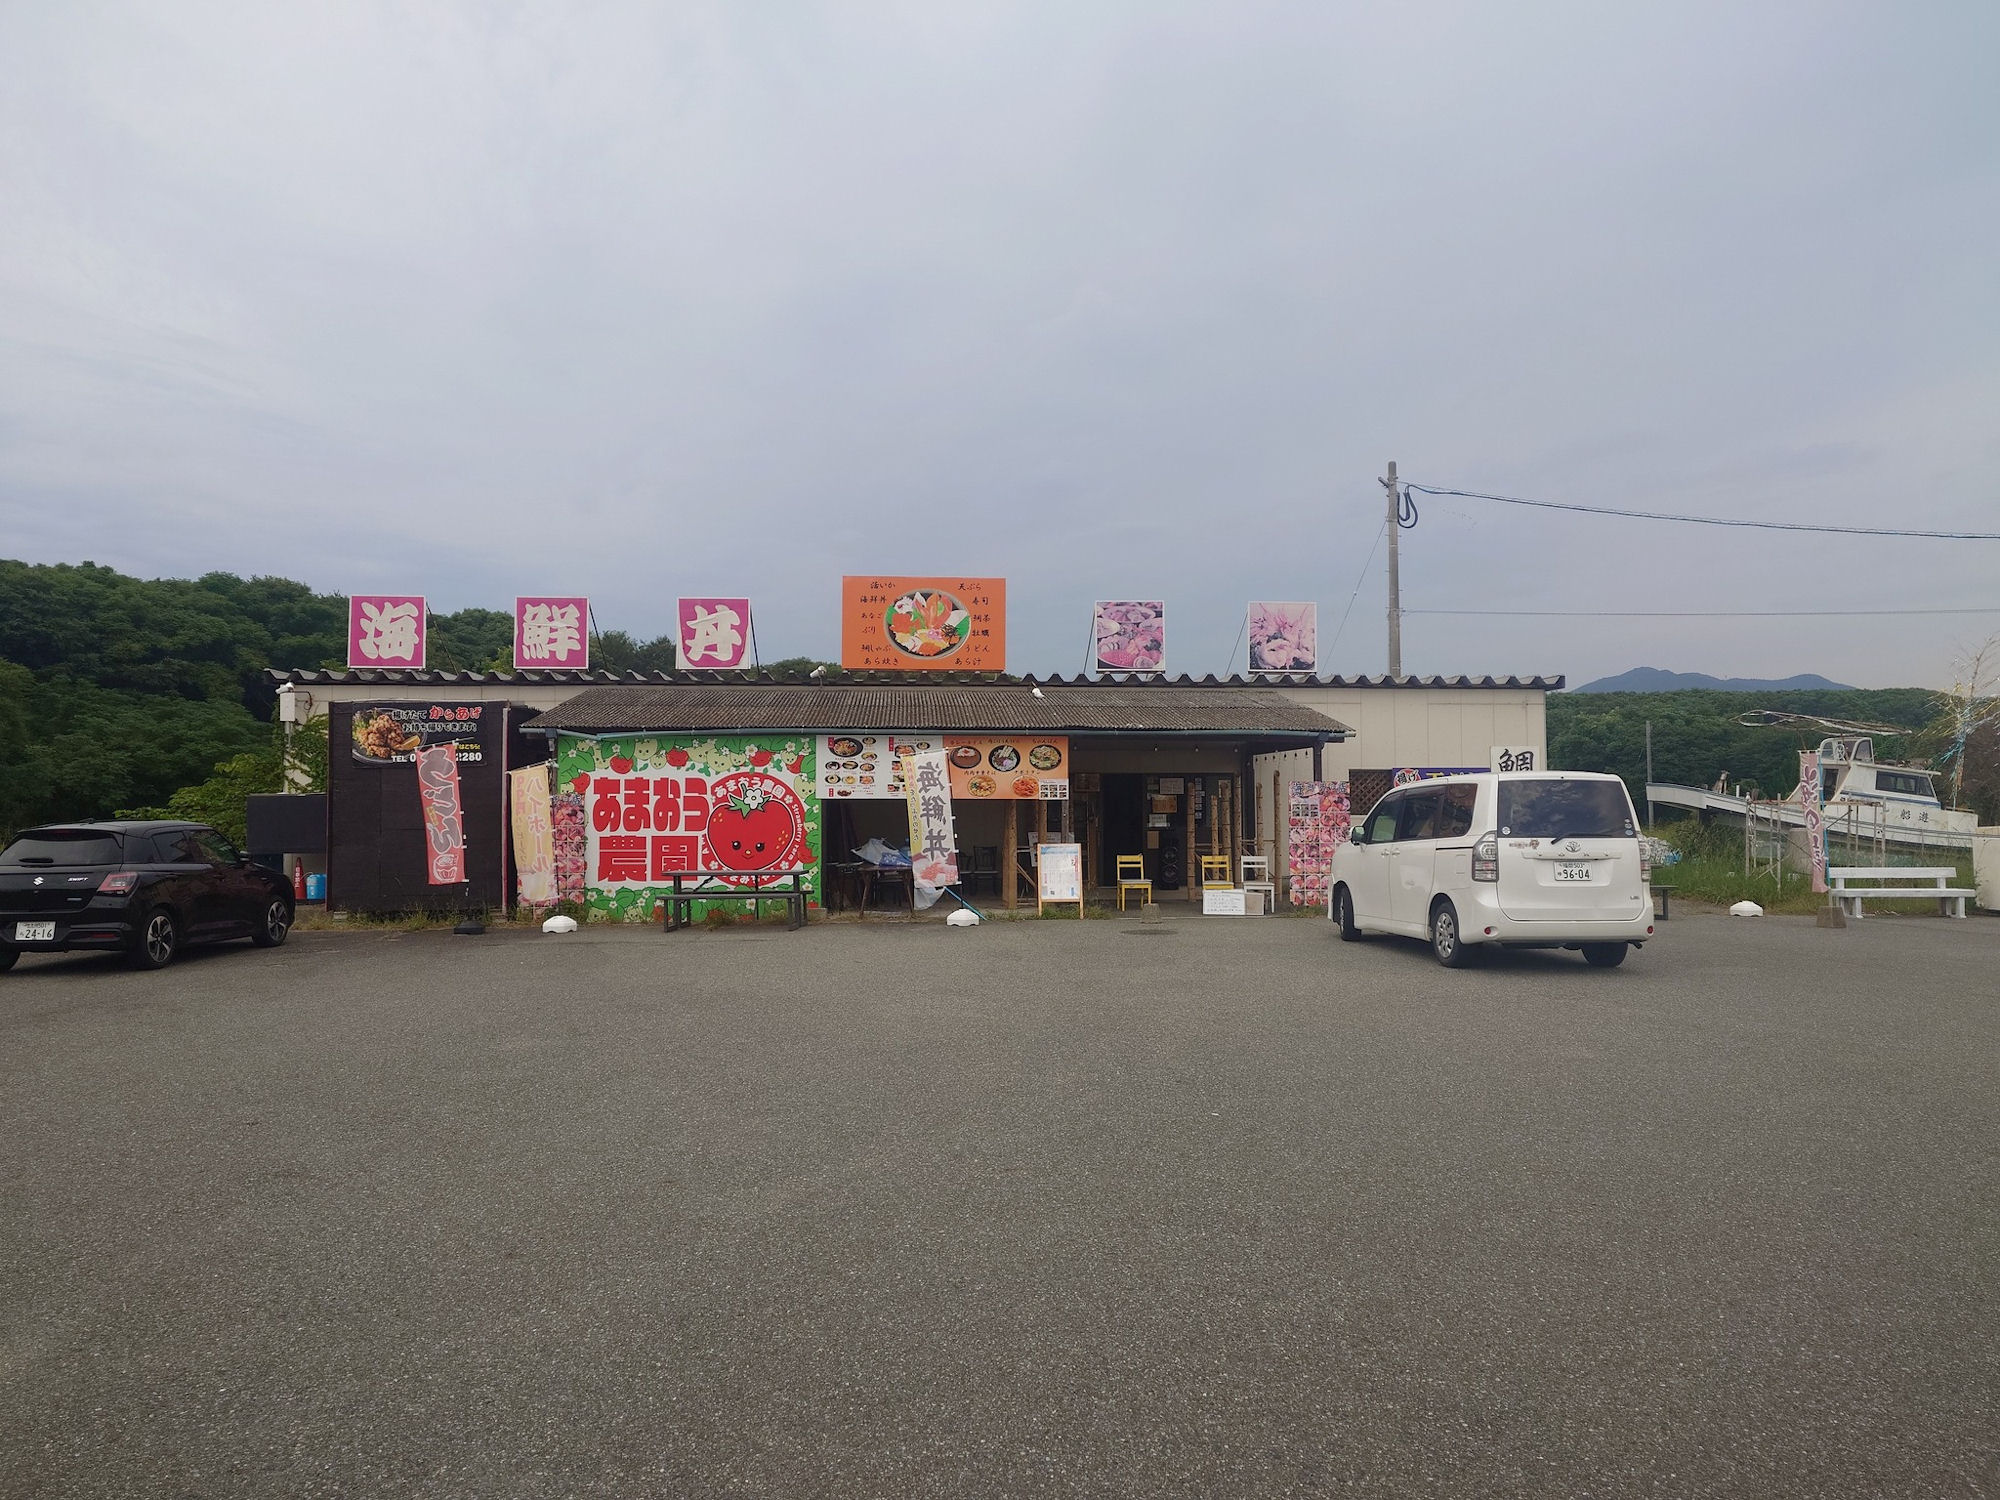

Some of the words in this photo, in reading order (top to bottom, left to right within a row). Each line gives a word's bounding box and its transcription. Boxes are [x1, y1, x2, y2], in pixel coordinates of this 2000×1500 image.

[870, 581, 896, 589] 活いか
[958, 582, 982, 590] 天ぷら
[860, 595, 887, 603] 海鮮丼
[972, 596, 989, 605] 寿司
[359, 601, 420, 662] 海
[521, 603, 581, 662] 鮮
[685, 604, 742, 662] 丼
[972, 629, 990, 637] 牡蠣
[861, 644, 891, 652] 鯛しゃぶ
[965, 644, 990, 652] うどん
[863, 657, 900, 666] あら炊き
[954, 657, 981, 665] あら汁
[429, 705, 482, 720] からあげ
[391, 755, 408, 763] TEL
[1498, 749, 1534, 772] 鯛
[593, 777, 710, 832] あまおう
[792, 803, 803, 843] Strawberry
[598, 835, 699, 882] 農園
[1563, 869, 1590, 879] 96-04
[25, 929, 52, 939] 24-16
